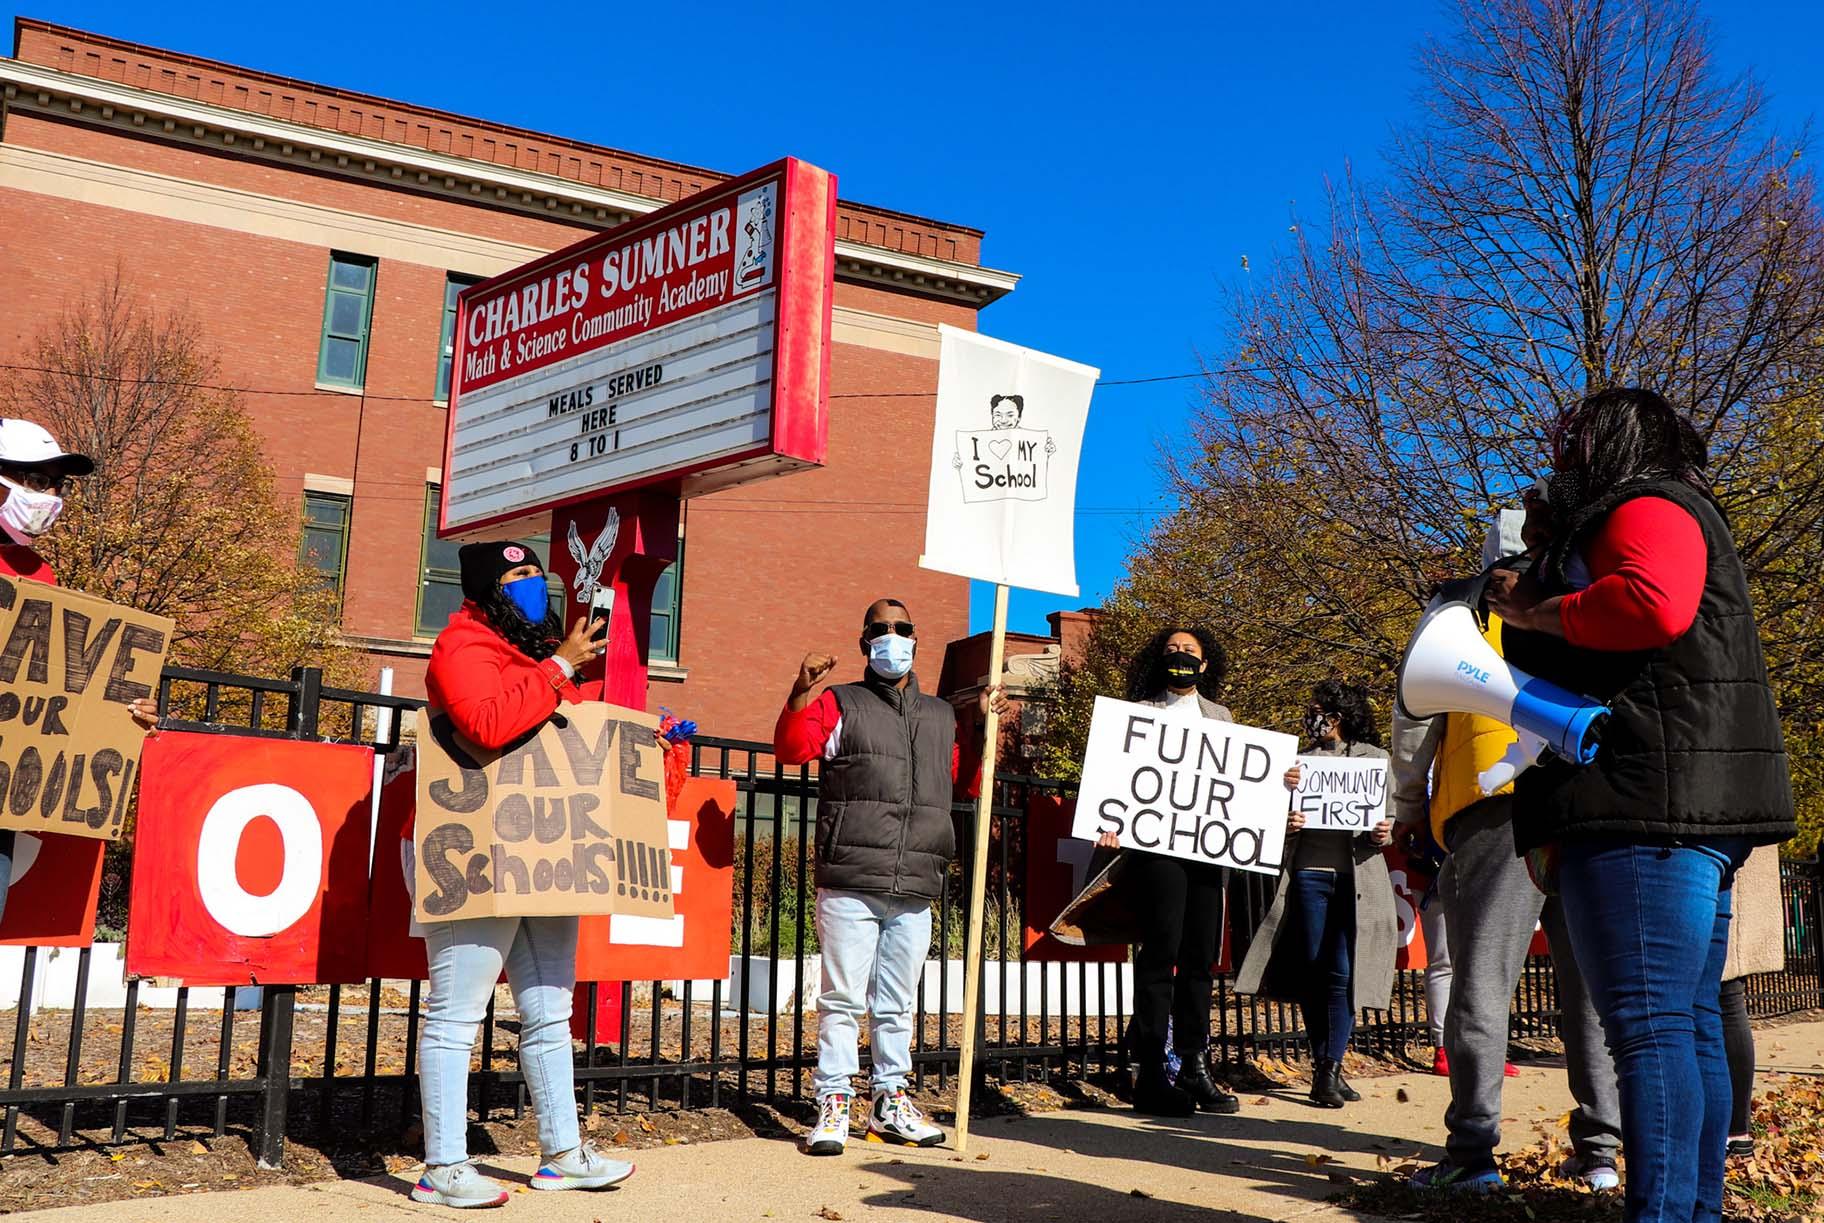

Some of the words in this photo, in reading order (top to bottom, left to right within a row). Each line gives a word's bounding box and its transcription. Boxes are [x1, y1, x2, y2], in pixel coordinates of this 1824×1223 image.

[468, 262, 590, 347] CHARLES
[600, 207, 731, 298] SUMNER
[464, 345, 496, 383] Math
[500, 338, 512, 371] &
[516, 328, 567, 365] Science
[572, 293, 654, 345] Community
[657, 268, 729, 316] Academy
[548, 386, 593, 418] MEALS
[607, 364, 663, 399] SERVED
[581, 404, 617, 433] HERE
[570, 442, 579, 462] 8
[588, 434, 607, 457] TO
[971, 436, 980, 461] I
[1017, 439, 1038, 462] MY
[974, 463, 1037, 490] School
[0, 576, 166, 705] AVE
[1122, 714, 1271, 784] FUND
[494, 792, 613, 845] OUR
[1130, 765, 1235, 821] OUR
[1300, 794, 1375, 828] FIRST
[1096, 798, 1281, 870] SCHOOL
